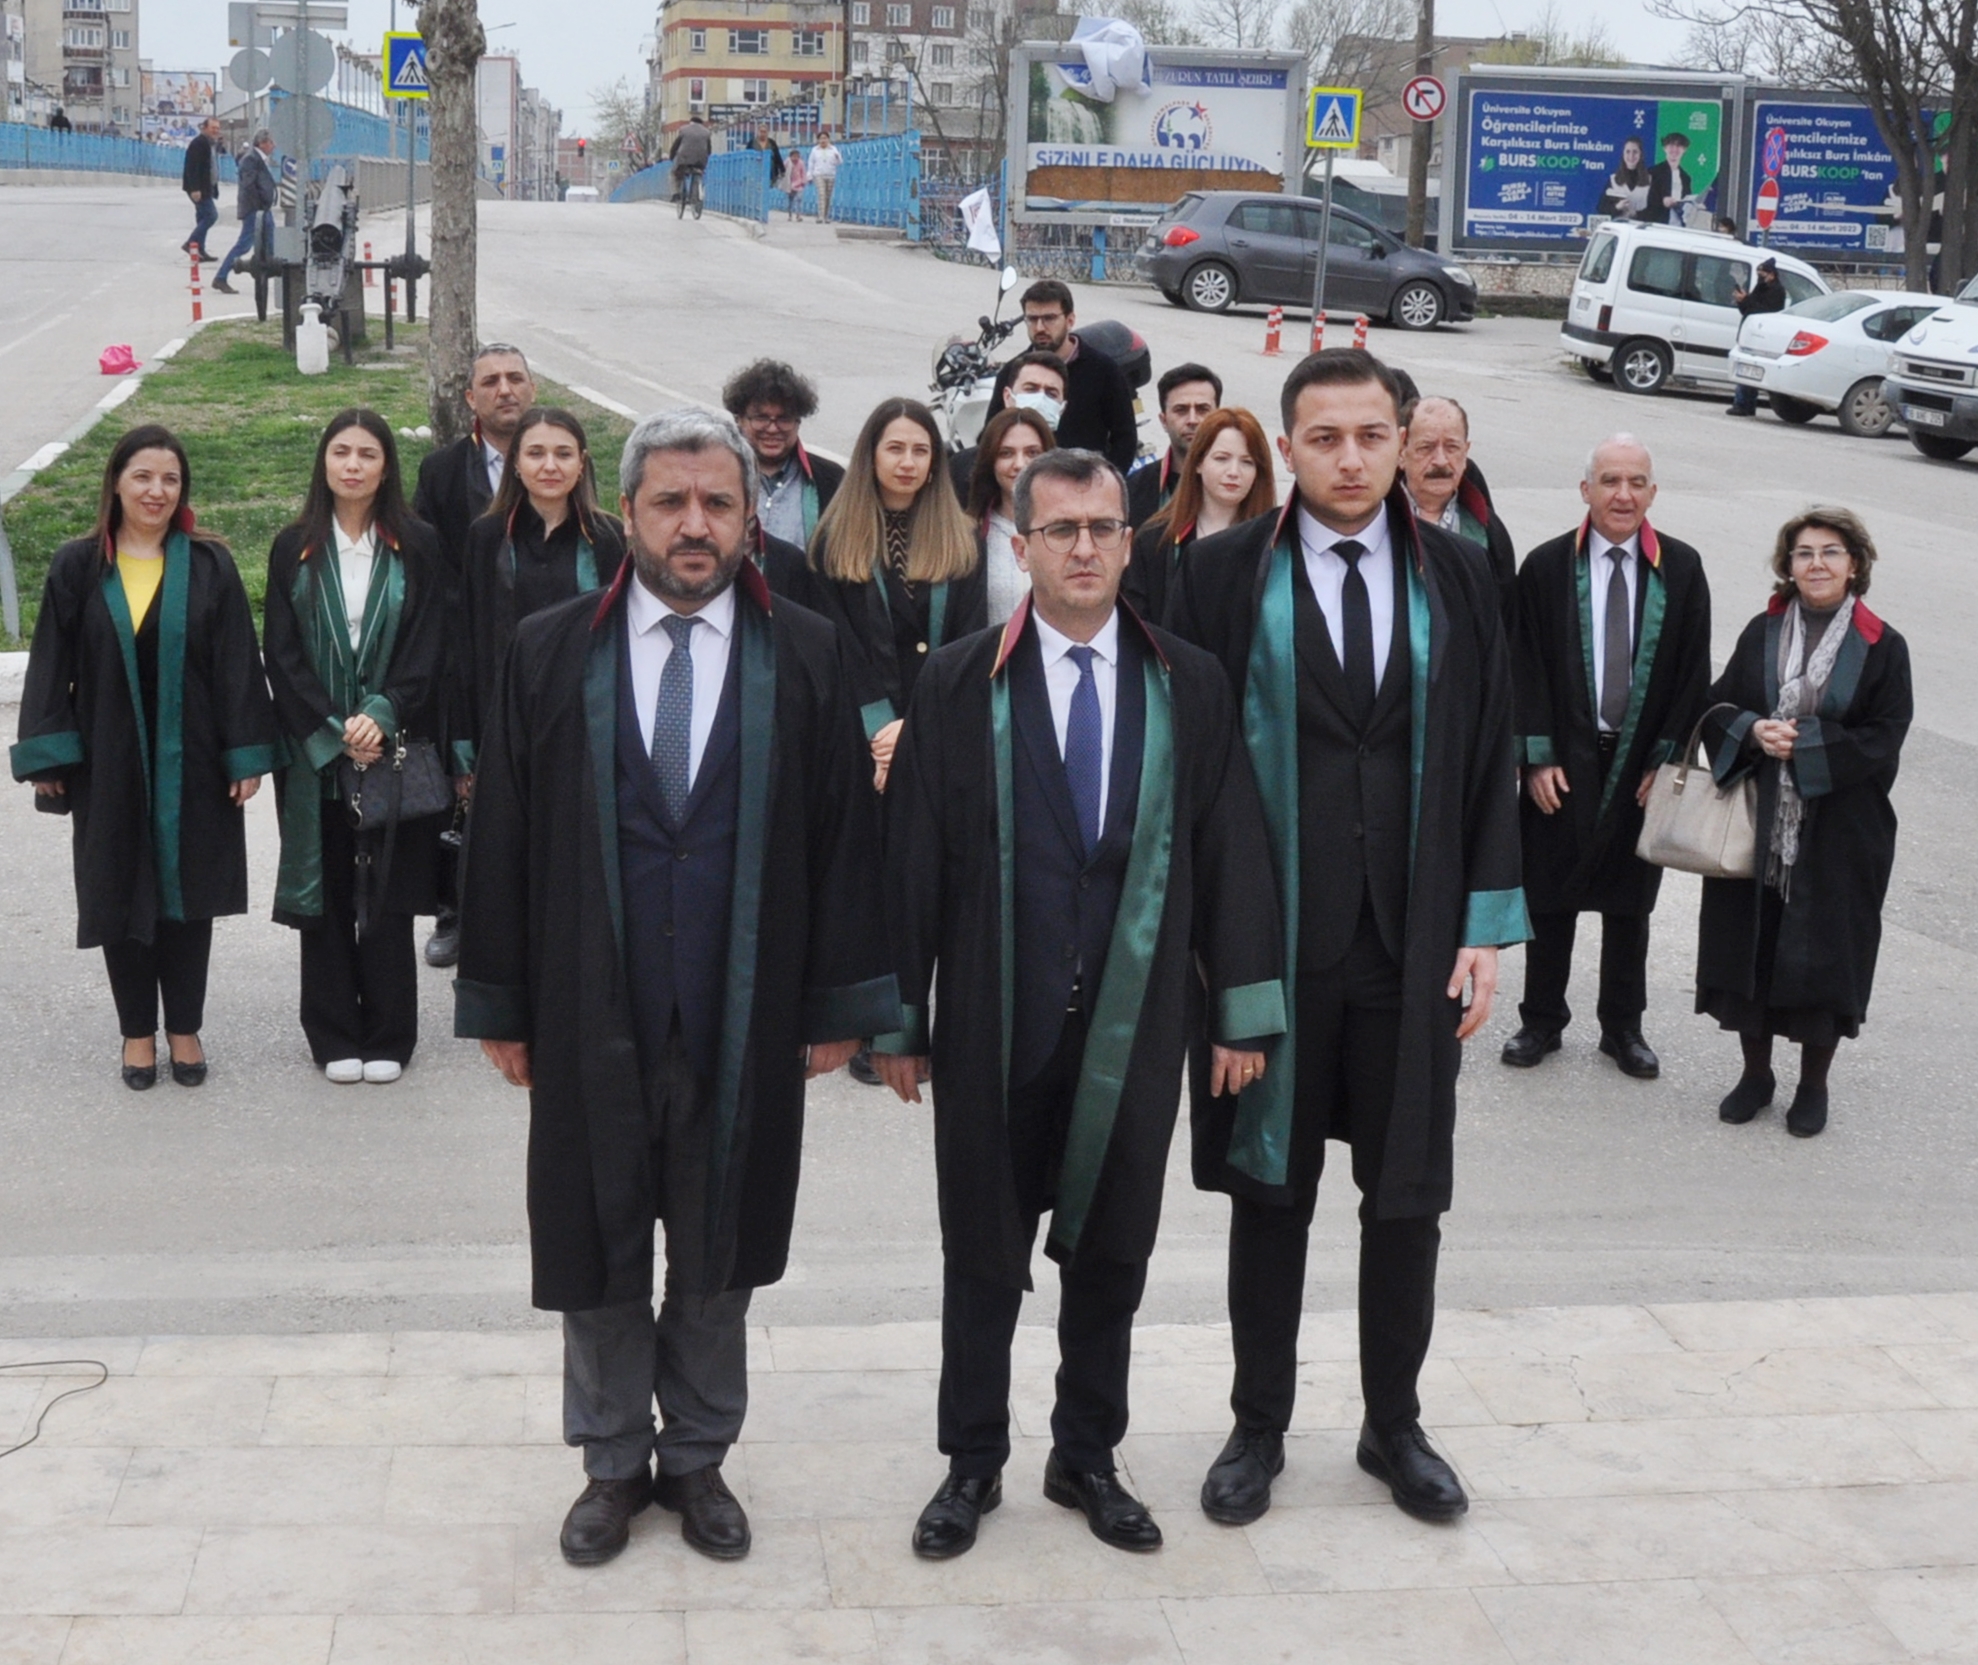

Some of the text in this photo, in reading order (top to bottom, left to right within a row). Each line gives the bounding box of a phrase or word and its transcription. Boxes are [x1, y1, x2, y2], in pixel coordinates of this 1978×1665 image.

[1482, 101, 1571, 118] Üniversite Okuyan
[1481, 115, 1589, 135] Öğrencilerimize
[1766, 114, 1851, 129] Üniversite Okuyan
[1481, 136, 1541, 149] Karşılıksız
[1544, 139, 1570, 150] Burs
[1765, 128, 1868, 145] rencilerimize
[1113, 152, 1165, 169] DAHA
[1498, 153, 1580, 168] BURSKOOP
[1785, 148, 1822, 161] şılıksız
[1825, 150, 1850, 161] Burs
[1781, 164, 1859, 179] BURSKOOP
[1538, 214, 1557, 222] Mart
[1558, 215, 1578, 223] 2022
[1807, 224, 1816, 232] 14
[1838, 225, 1857, 233] 2022
